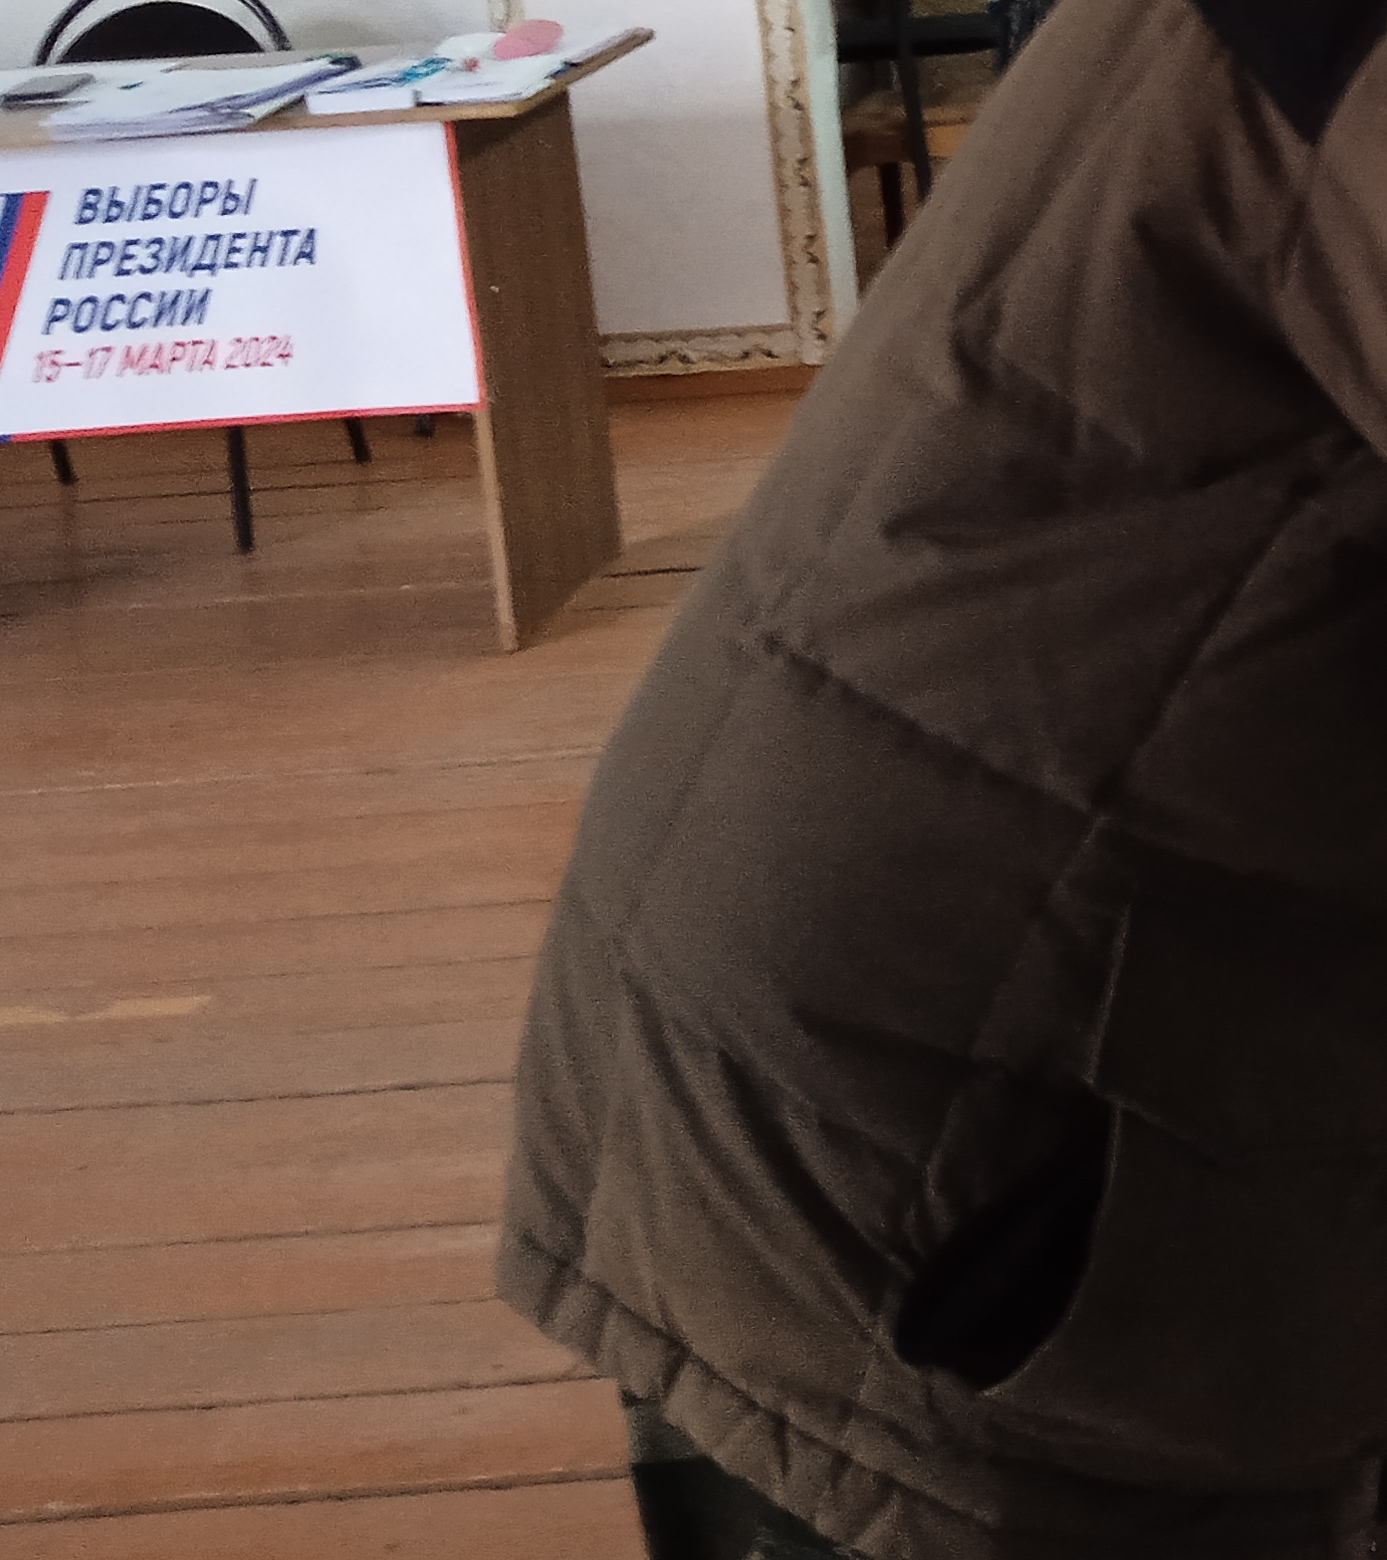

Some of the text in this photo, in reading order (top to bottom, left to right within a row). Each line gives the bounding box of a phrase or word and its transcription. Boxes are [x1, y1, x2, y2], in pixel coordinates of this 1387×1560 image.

[75, 178, 258, 226] ВЫБОРЫ
[57, 226, 318, 281] ПРЕЗИДЕНТА
[40, 287, 213, 335] РОССИИ
[115, 338, 219, 378] МАРТА
[223, 334, 294, 371] 2024
